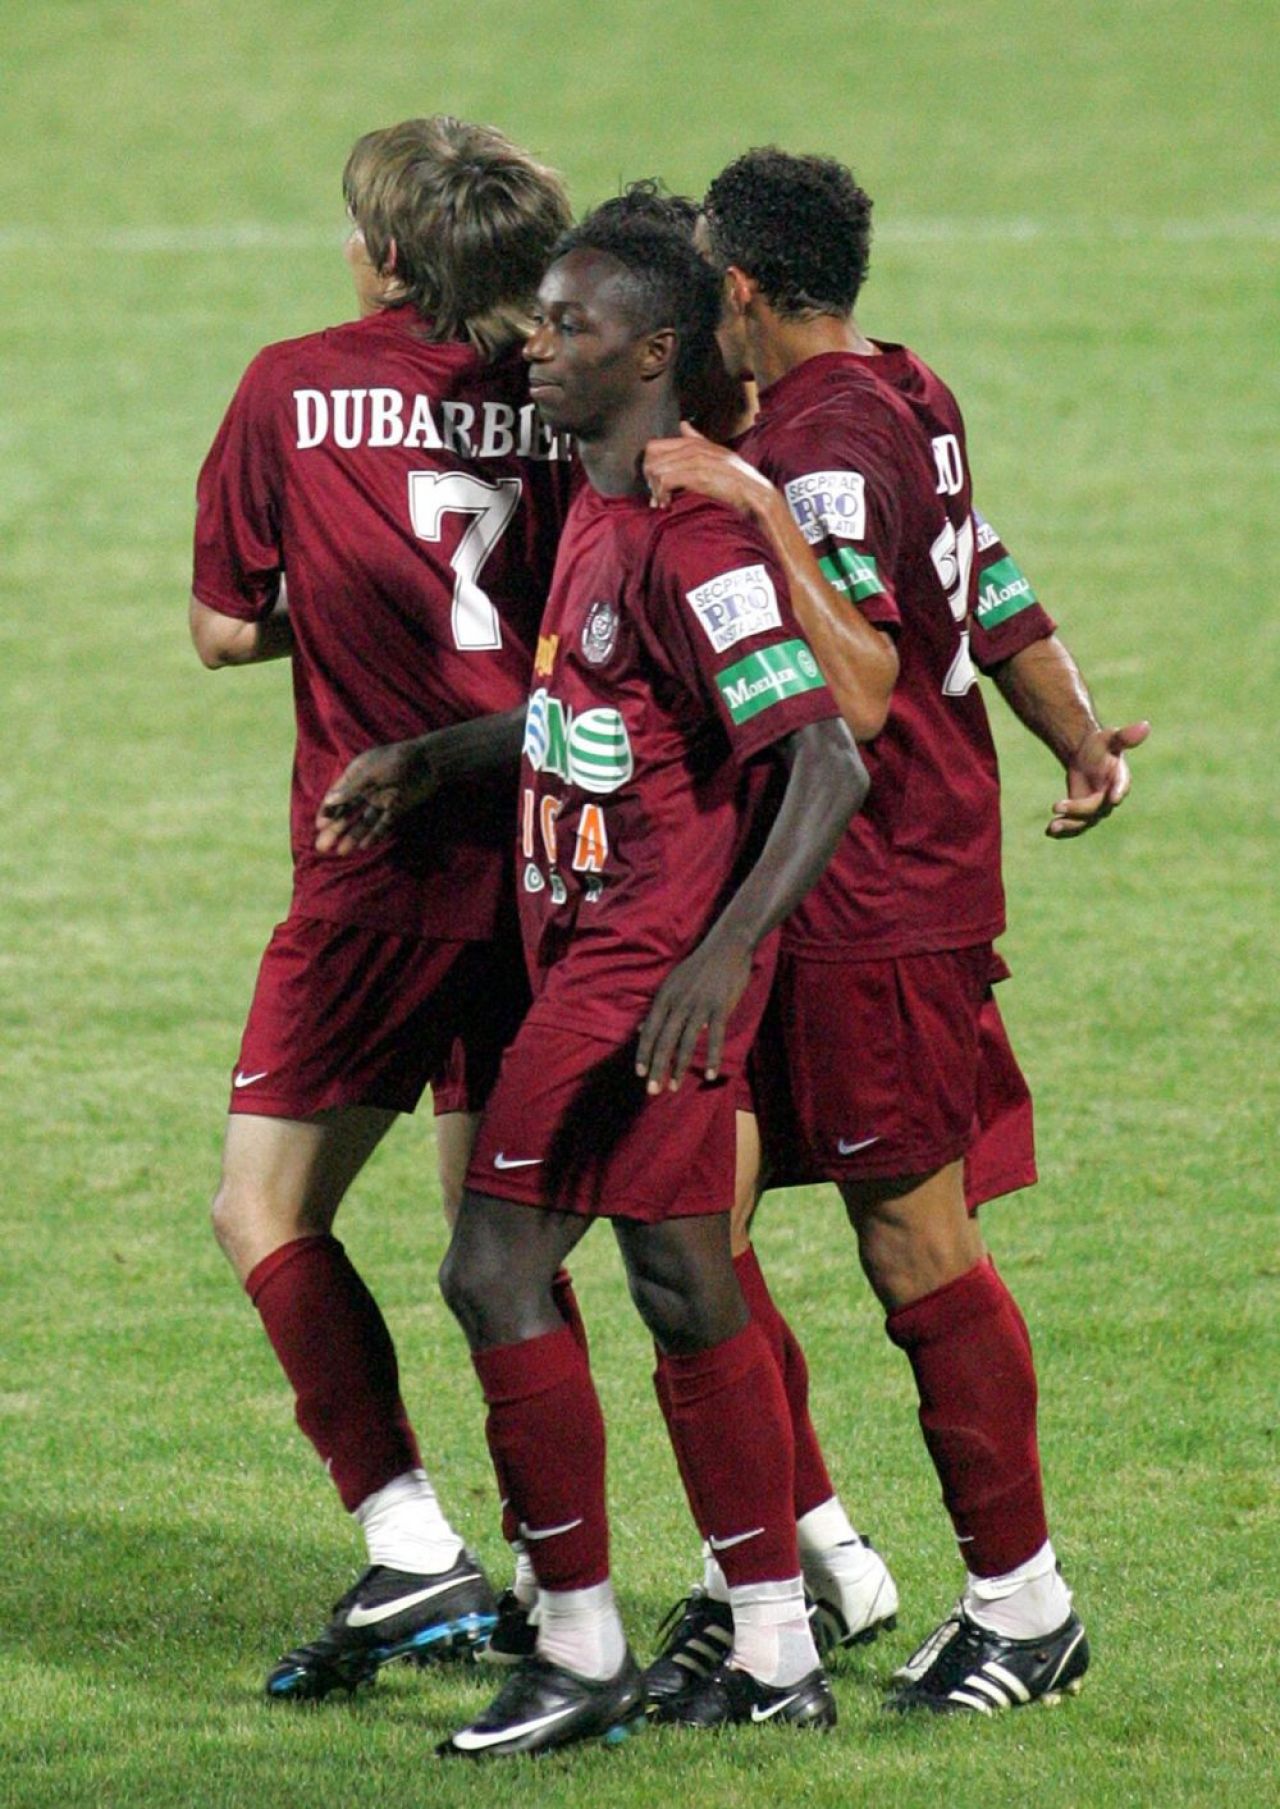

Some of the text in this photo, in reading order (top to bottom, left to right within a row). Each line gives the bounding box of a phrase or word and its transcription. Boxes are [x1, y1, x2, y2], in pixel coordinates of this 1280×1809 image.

[293, 388, 571, 461] DUBARBIE
[792, 490, 859, 527] PRO
[408, 470, 522, 650] 7
[701, 585, 769, 633] PRO
